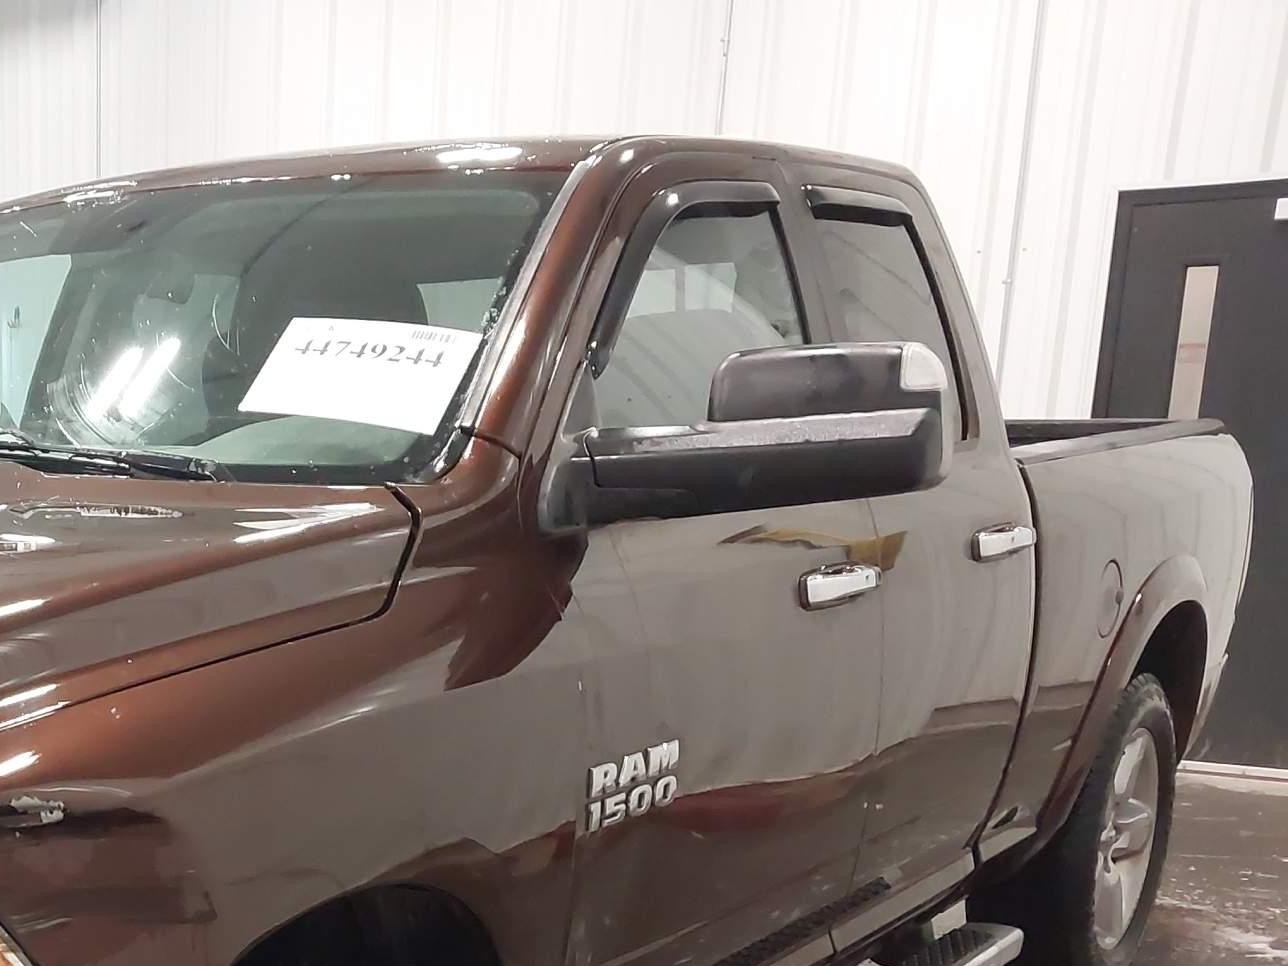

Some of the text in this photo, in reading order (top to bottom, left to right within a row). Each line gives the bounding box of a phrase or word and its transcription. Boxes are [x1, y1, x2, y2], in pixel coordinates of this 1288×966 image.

[295, 340, 444, 367] 44749244
[588, 739, 680, 797] RAM
[586, 775, 678, 832] 1500
